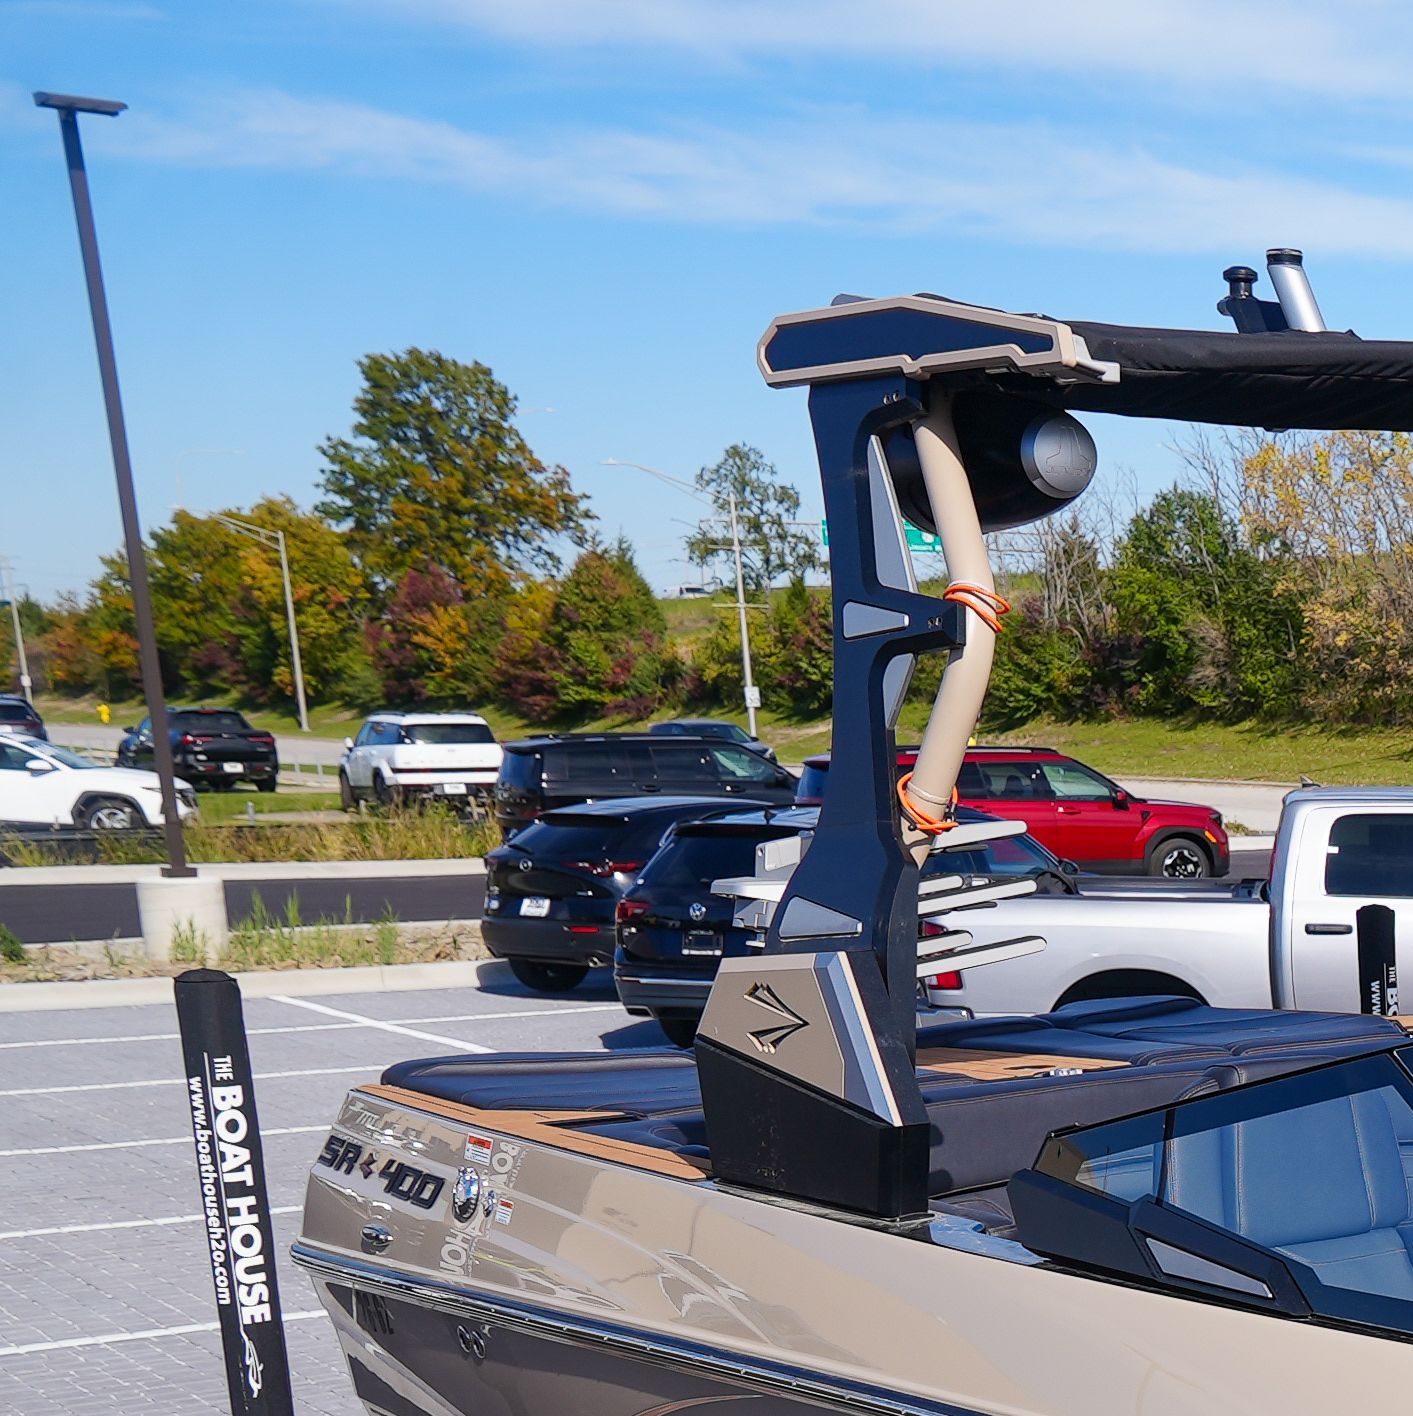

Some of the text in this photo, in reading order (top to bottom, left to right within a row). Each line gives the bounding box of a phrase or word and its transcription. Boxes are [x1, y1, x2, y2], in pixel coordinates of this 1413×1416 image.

[188, 1076, 231, 1305] www.boathouseh2o.com
[212, 1055, 272, 1325] THE BOAT HOUSE
[318, 1134, 363, 1175] SR
[378, 1158, 446, 1210] 400
